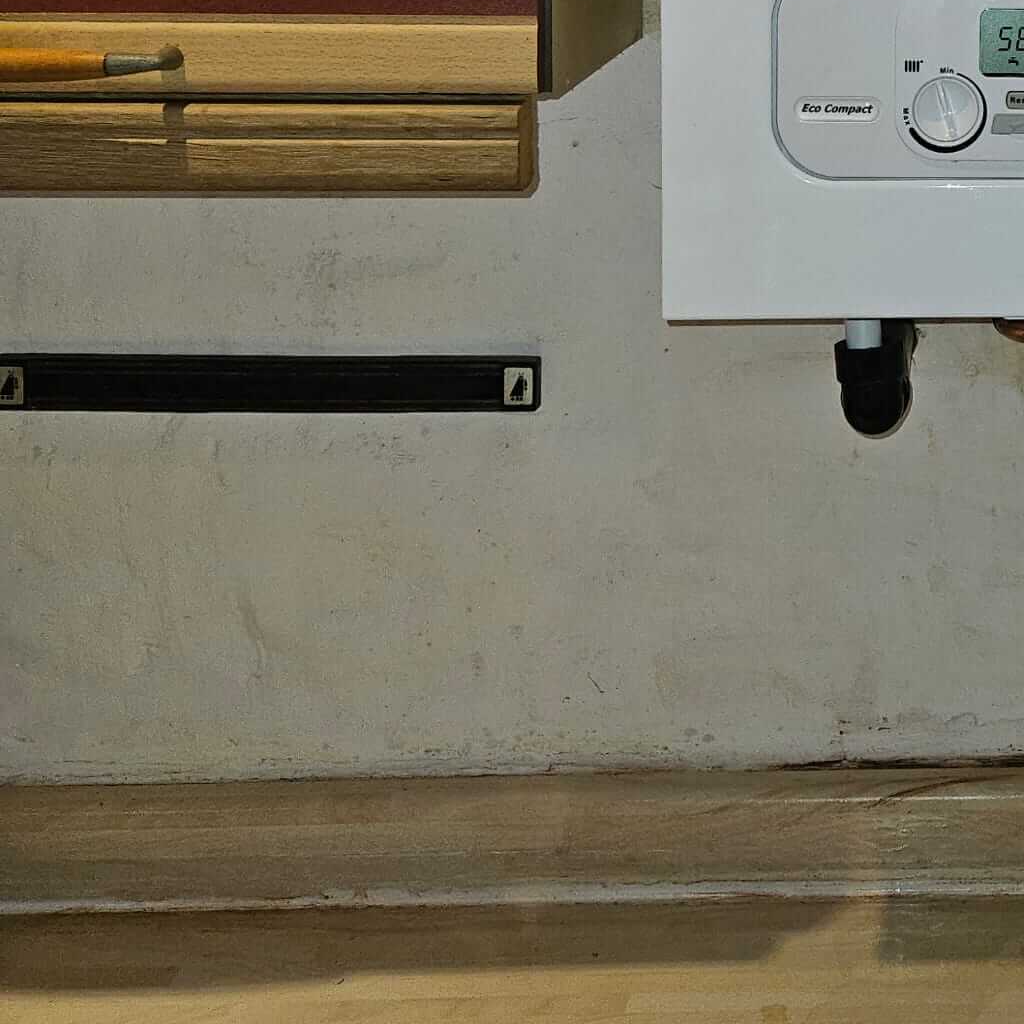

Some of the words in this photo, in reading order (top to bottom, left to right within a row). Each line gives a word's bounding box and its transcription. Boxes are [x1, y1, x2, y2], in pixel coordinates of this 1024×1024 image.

[940, 67, 955, 75] Min
[801, 103, 826, 114] Eco
[829, 103, 873, 116] Compact
